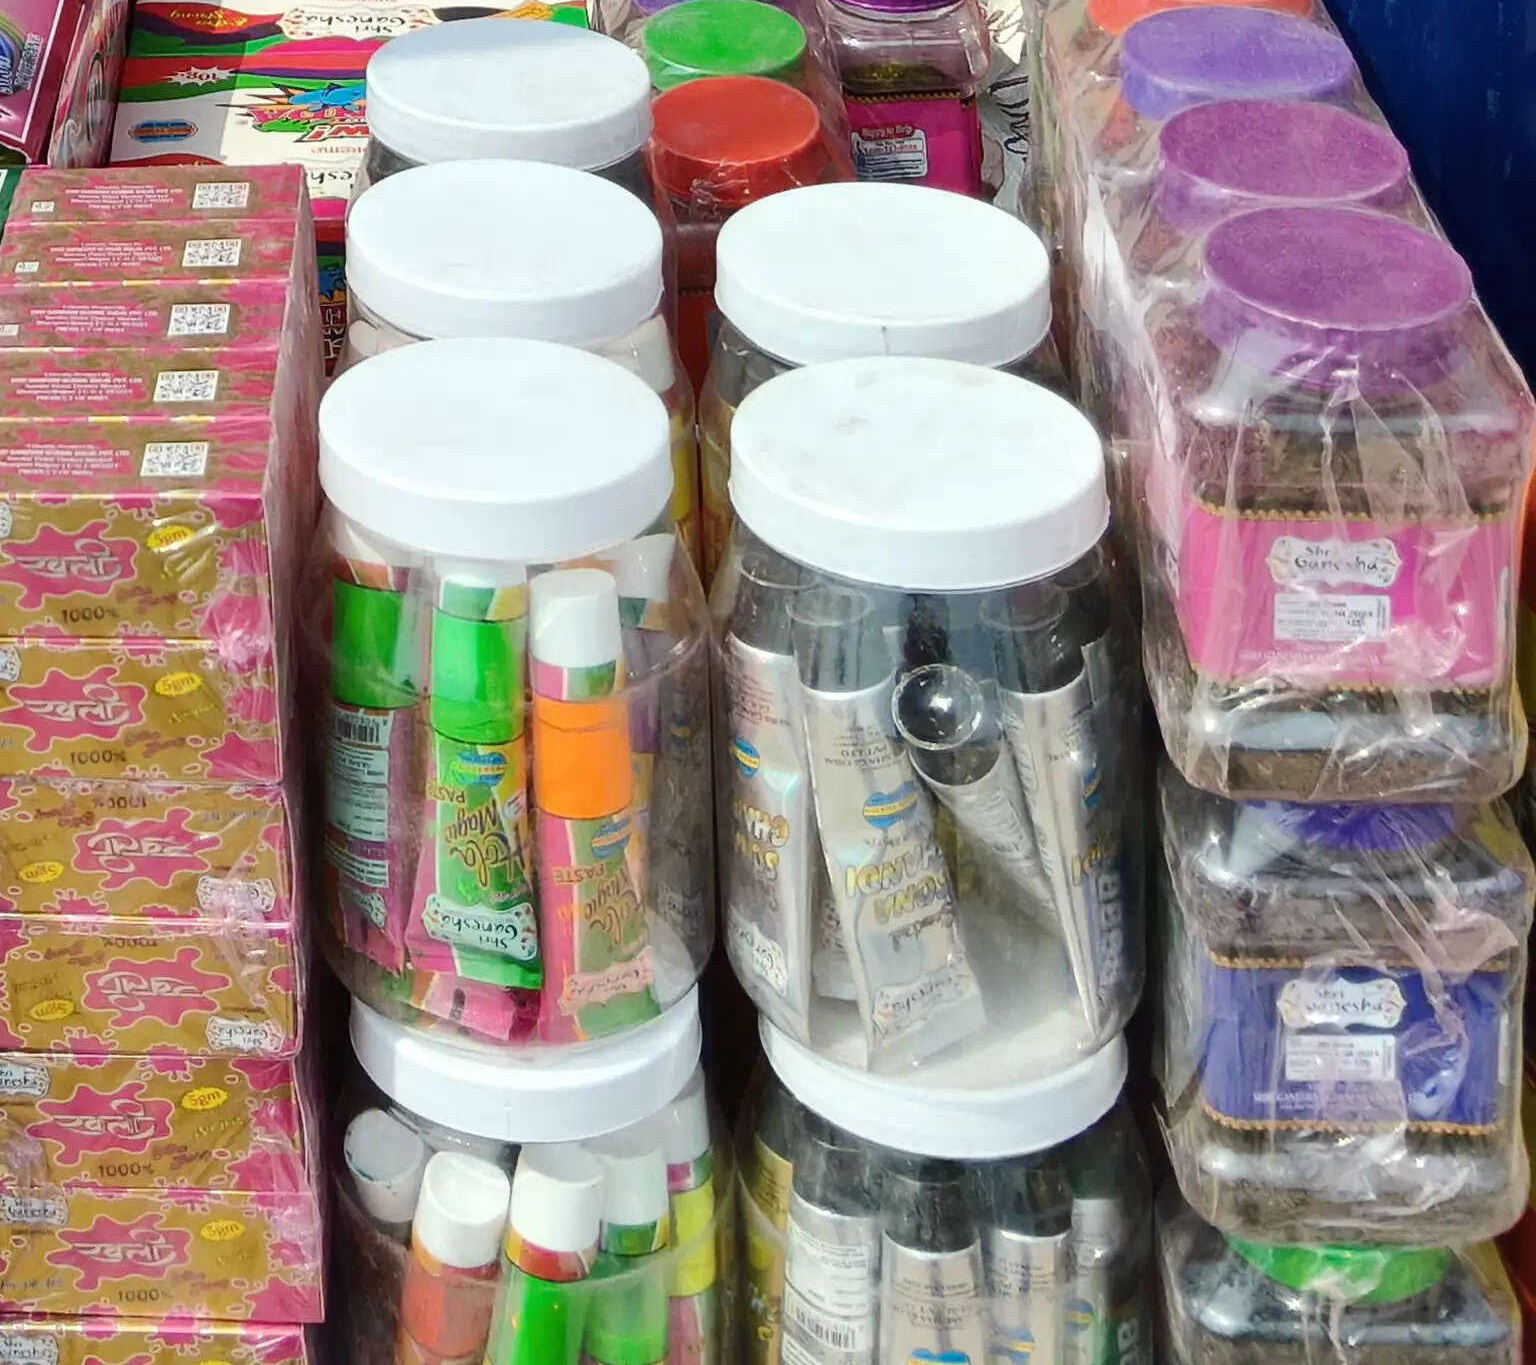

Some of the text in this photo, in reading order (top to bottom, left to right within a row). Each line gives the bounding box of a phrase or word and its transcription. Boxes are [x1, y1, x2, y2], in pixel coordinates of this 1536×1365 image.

[302, 13, 406, 26] Ganesha
[362, 23, 393, 35] Shri
[443, 798, 499, 845] Magic
[441, 914, 518, 939] Ganesha
[477, 935, 509, 949] Shri
[187, 1090, 222, 1107] 5gm
